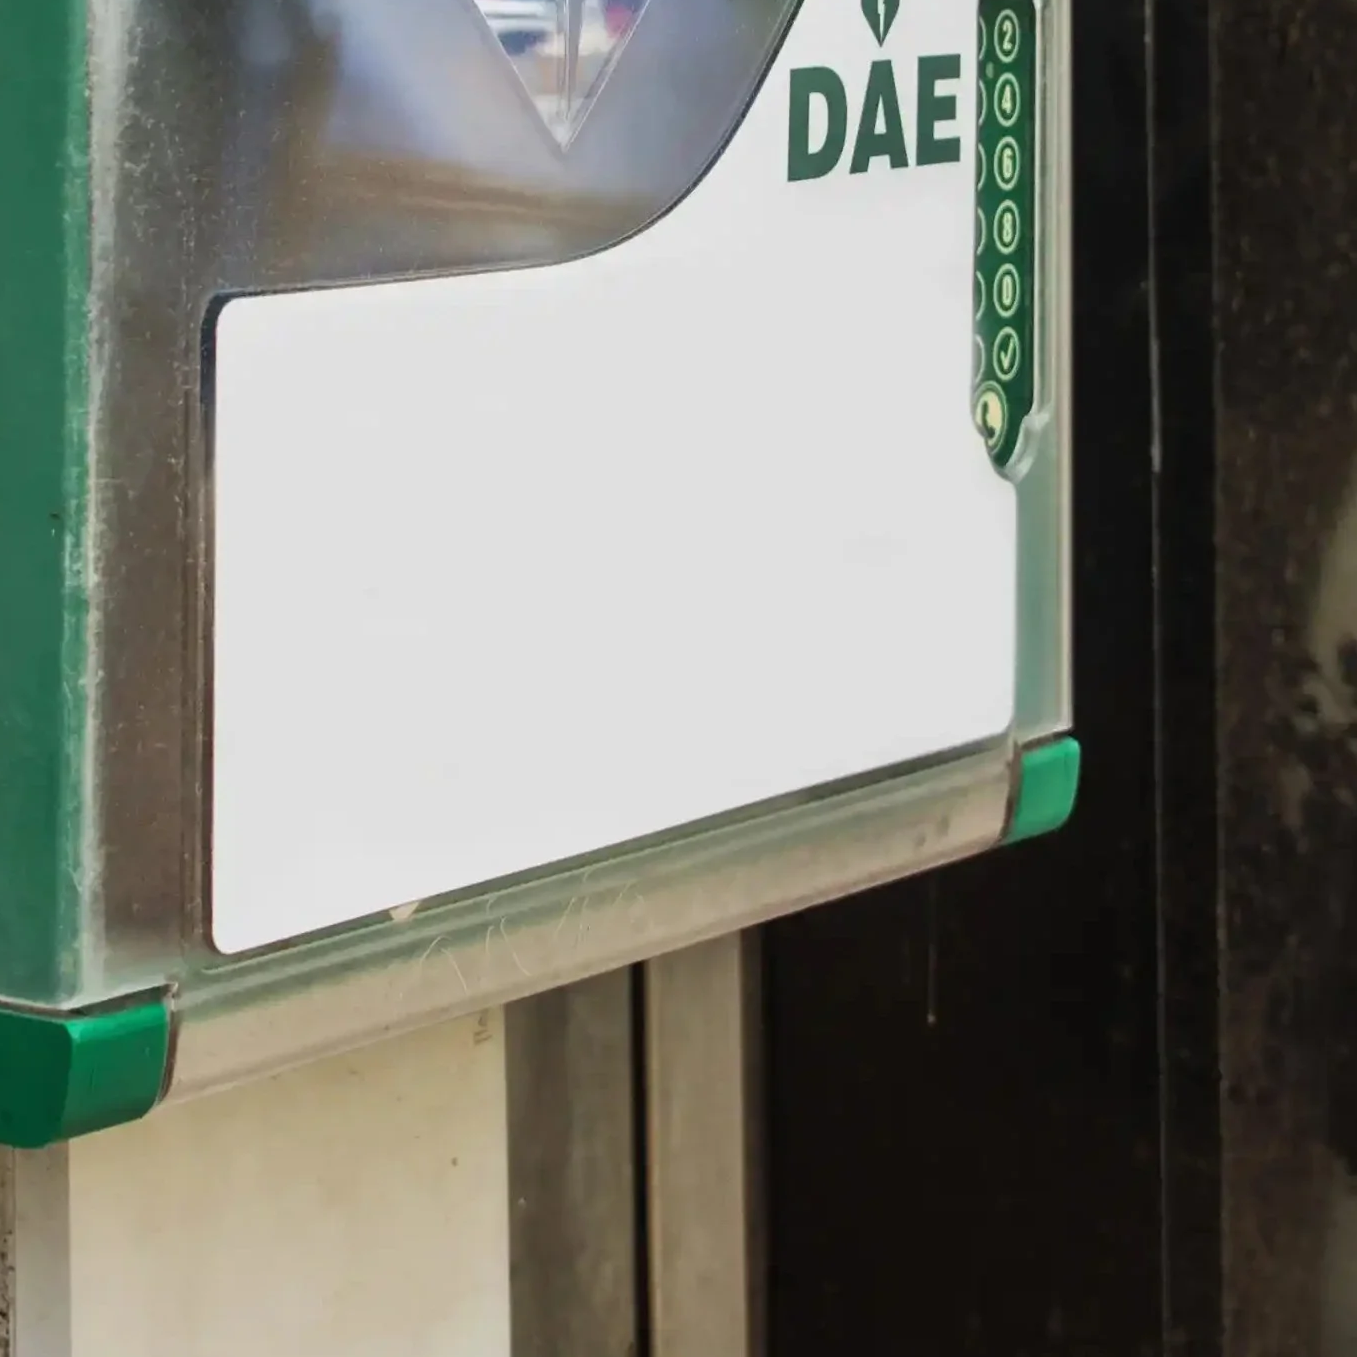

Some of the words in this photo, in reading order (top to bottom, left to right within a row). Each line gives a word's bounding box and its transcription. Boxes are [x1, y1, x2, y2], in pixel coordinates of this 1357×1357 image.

[1002, 19, 1013, 51] 2
[1001, 84, 1013, 114] 4
[788, 54, 961, 182] DAE
[1002, 147, 1013, 180] 6
[1002, 212, 1013, 244] 8
[1002, 274, 1013, 306] 0
